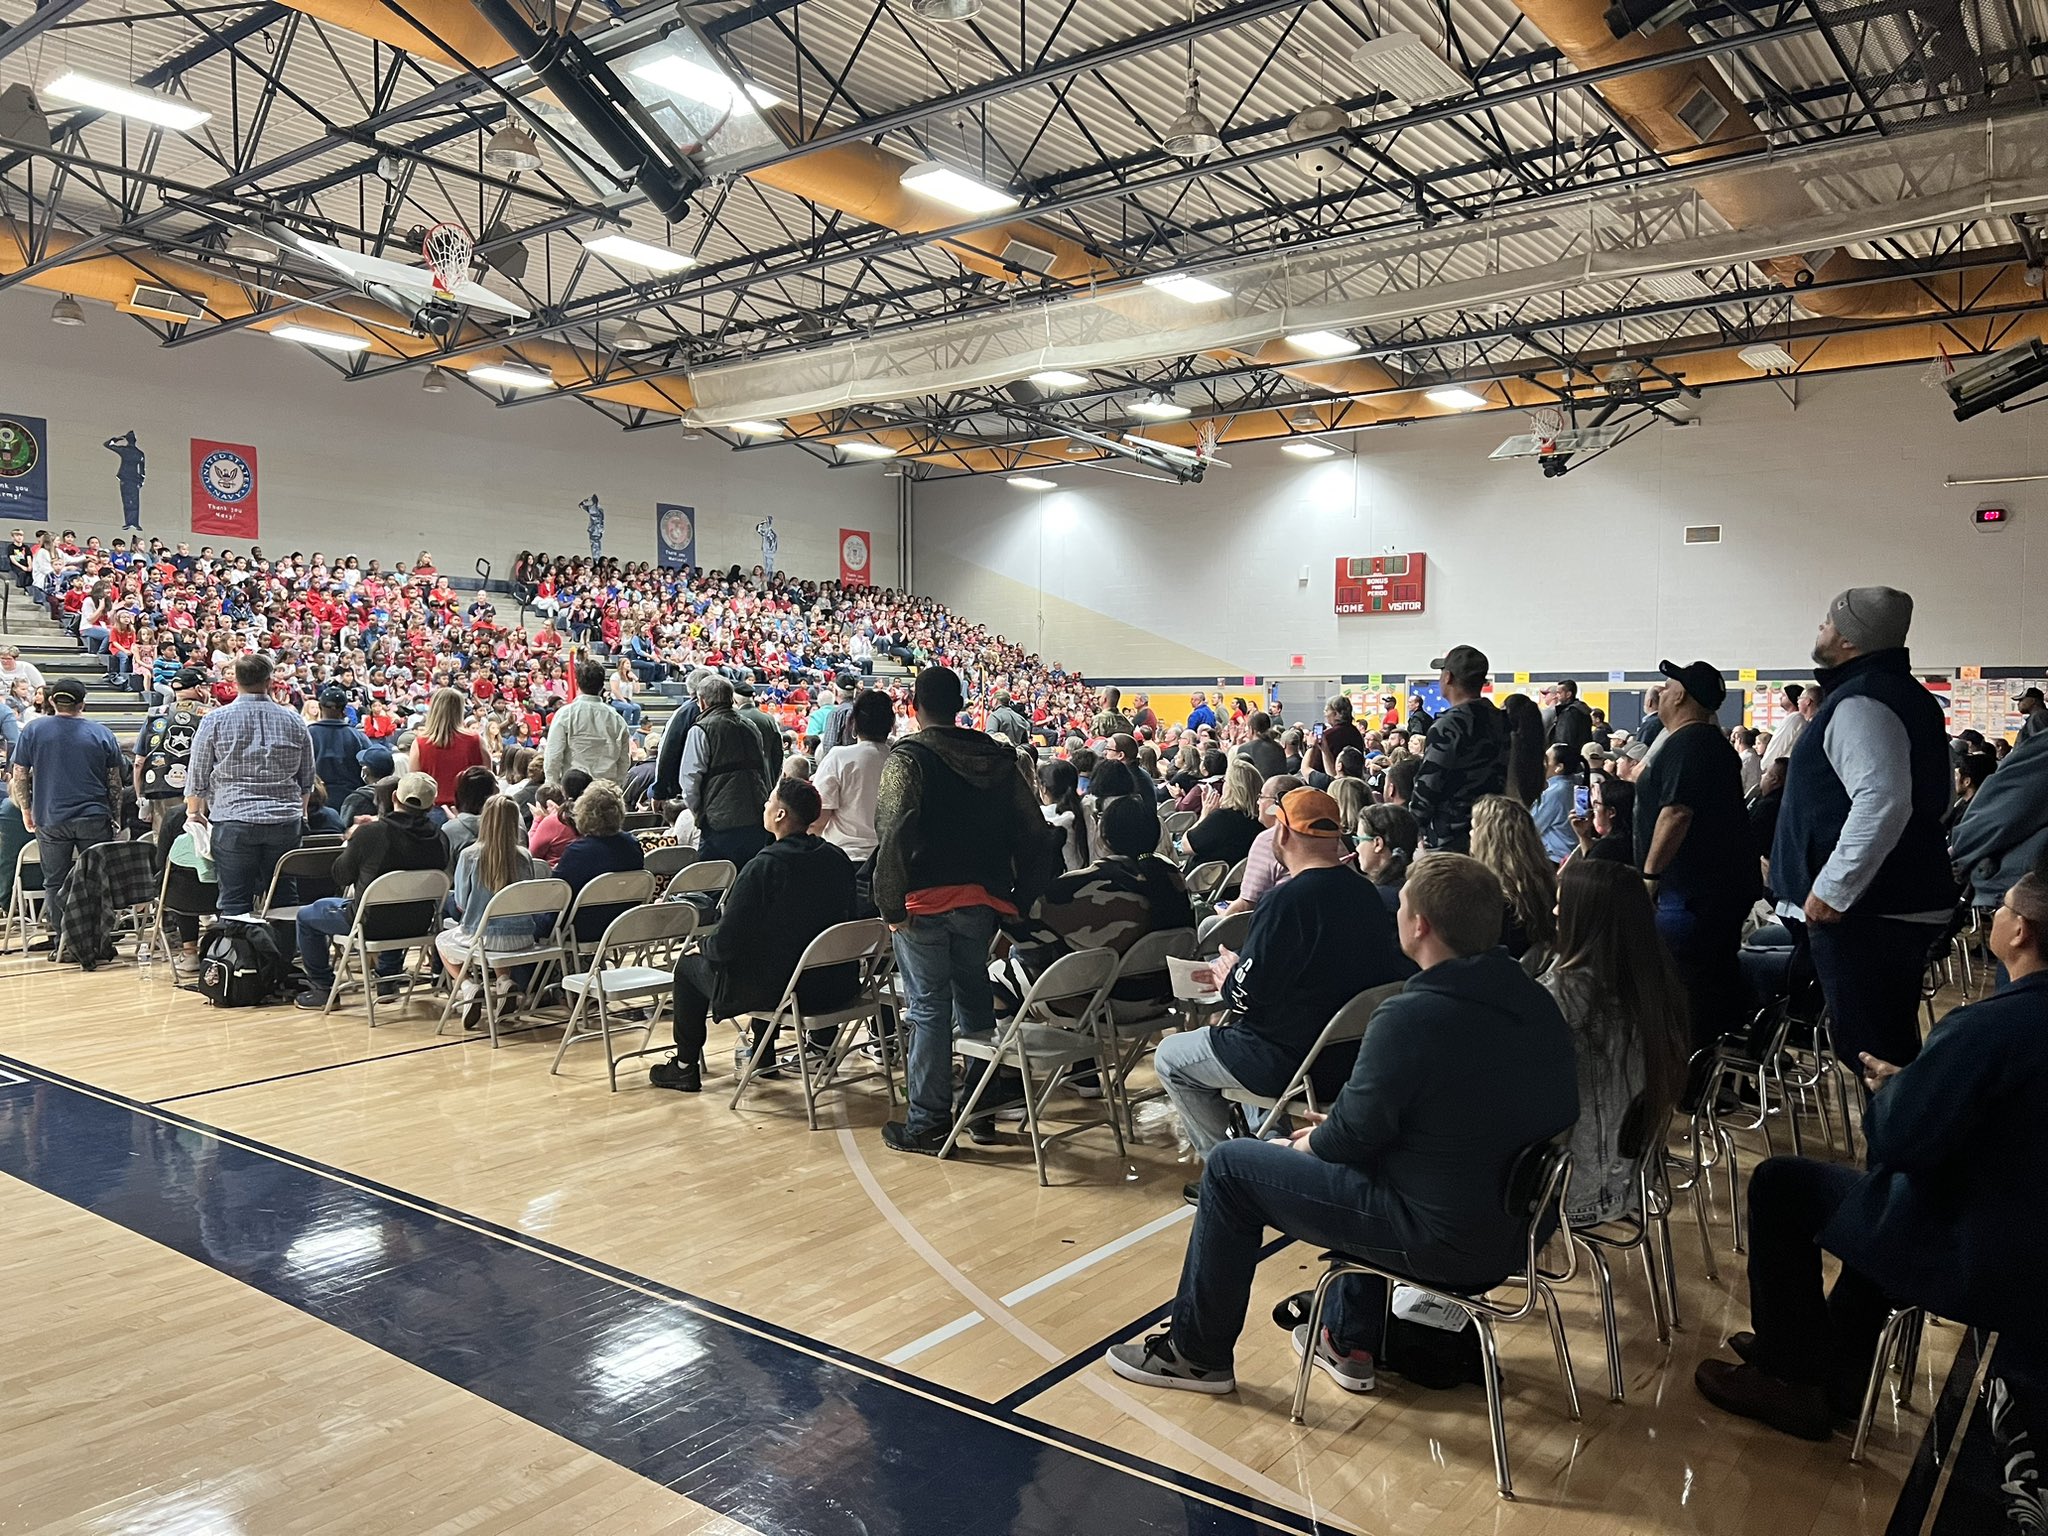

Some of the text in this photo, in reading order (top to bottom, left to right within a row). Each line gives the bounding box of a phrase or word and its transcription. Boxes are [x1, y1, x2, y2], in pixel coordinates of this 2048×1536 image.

[203, 453, 250, 489] UNITED STATES
[0, 491, 22, 500] rmy!
[212, 489, 241, 500] NAVY
[207, 503, 227, 511] Thank
[1336, 603, 1364, 613] HOME
[1388, 601, 1422, 611] VISITOR
